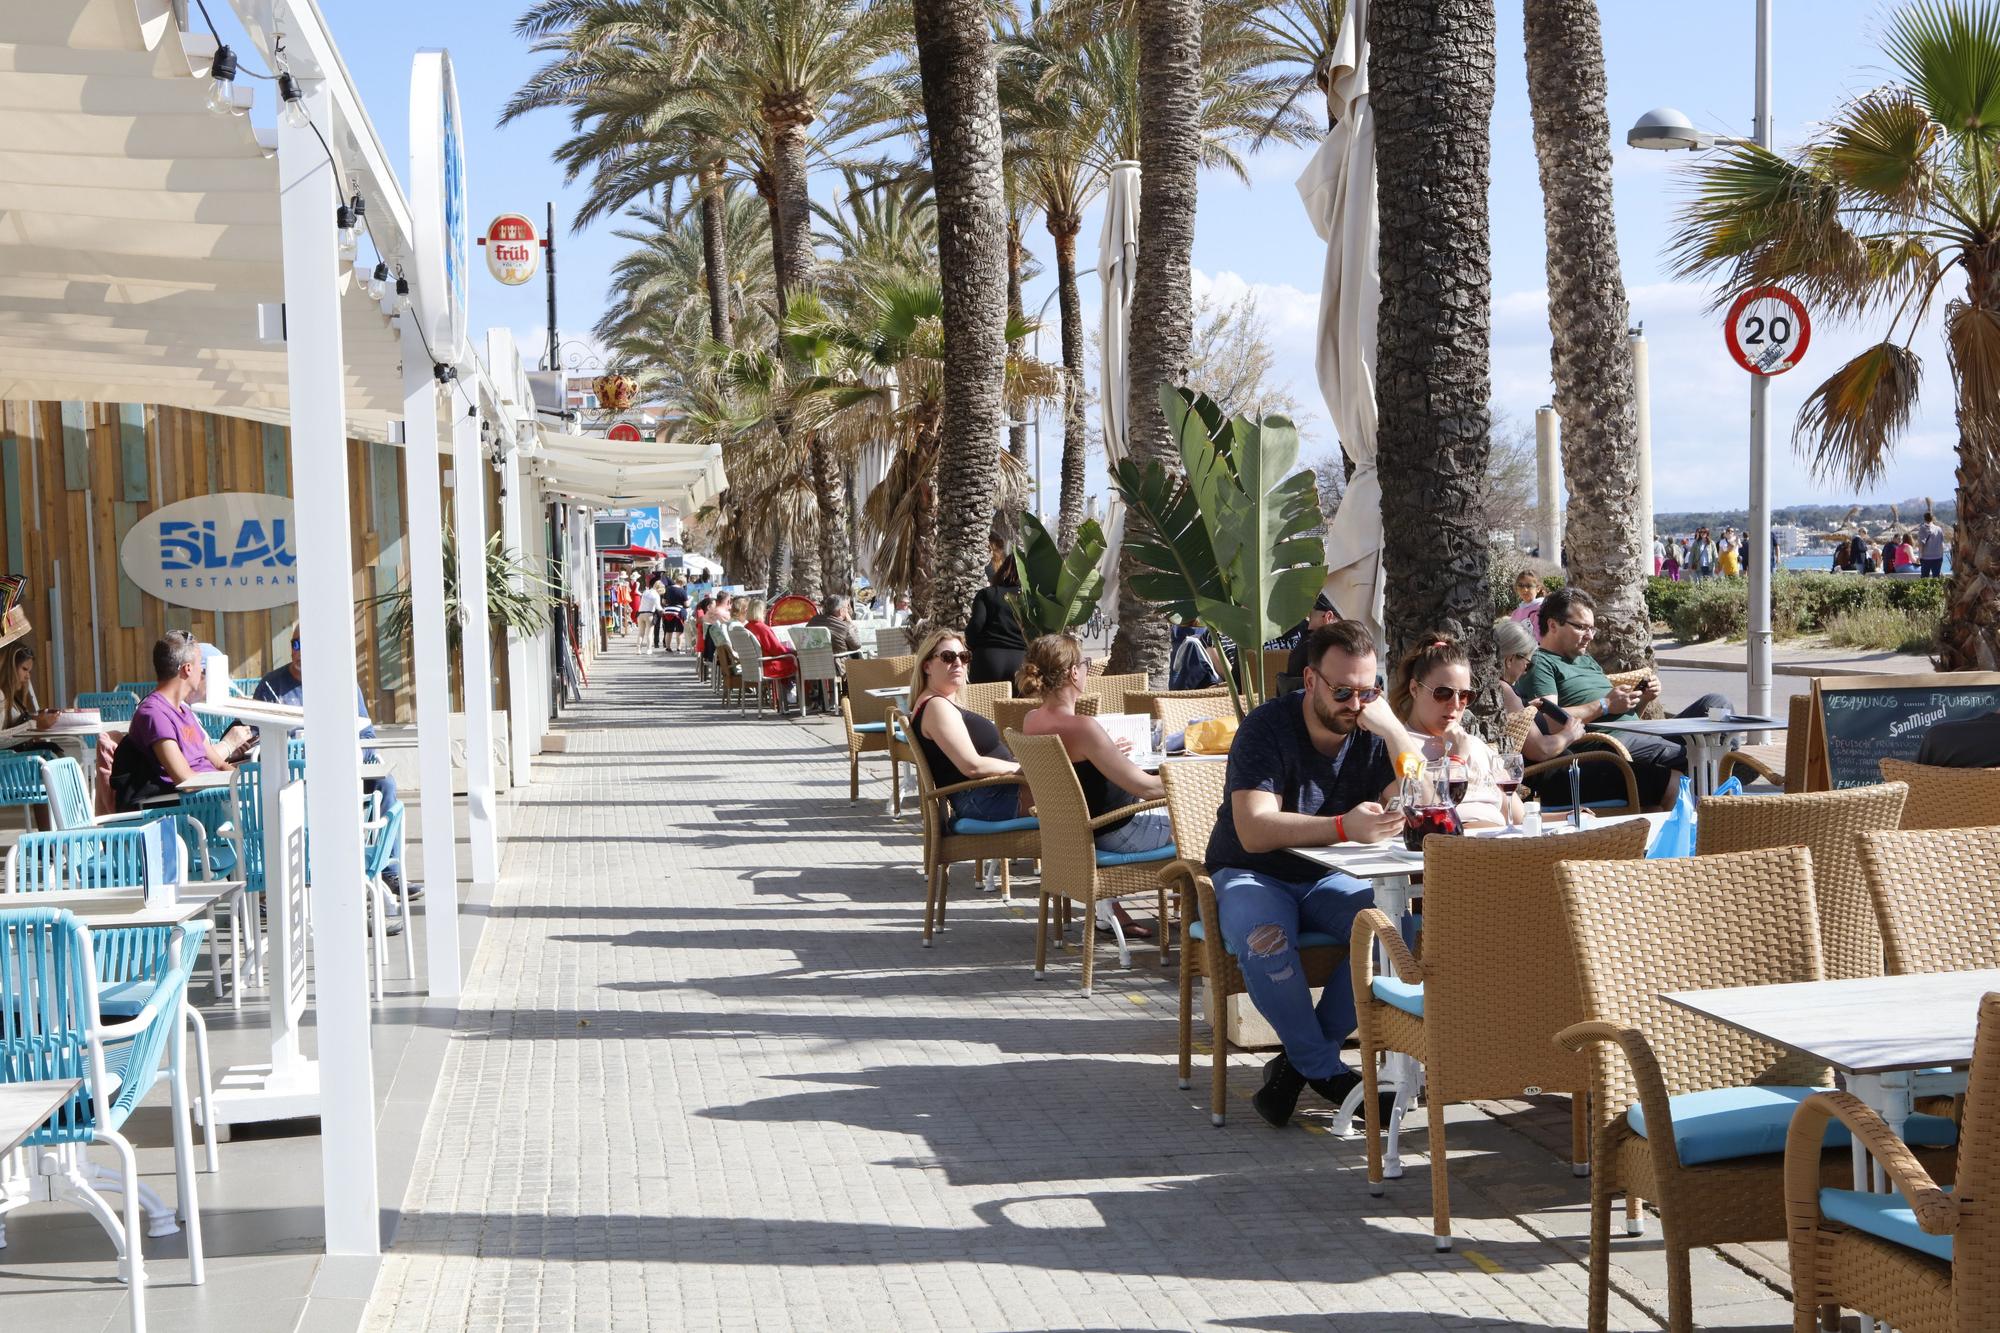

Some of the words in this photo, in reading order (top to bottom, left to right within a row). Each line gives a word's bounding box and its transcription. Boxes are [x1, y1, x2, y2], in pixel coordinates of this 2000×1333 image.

[1745, 317, 1790, 344] 20
[160, 519, 297, 569] BLAU
[165, 576, 296, 588] RESTAURAN
[1828, 694, 1898, 710] DESAYUNOS
